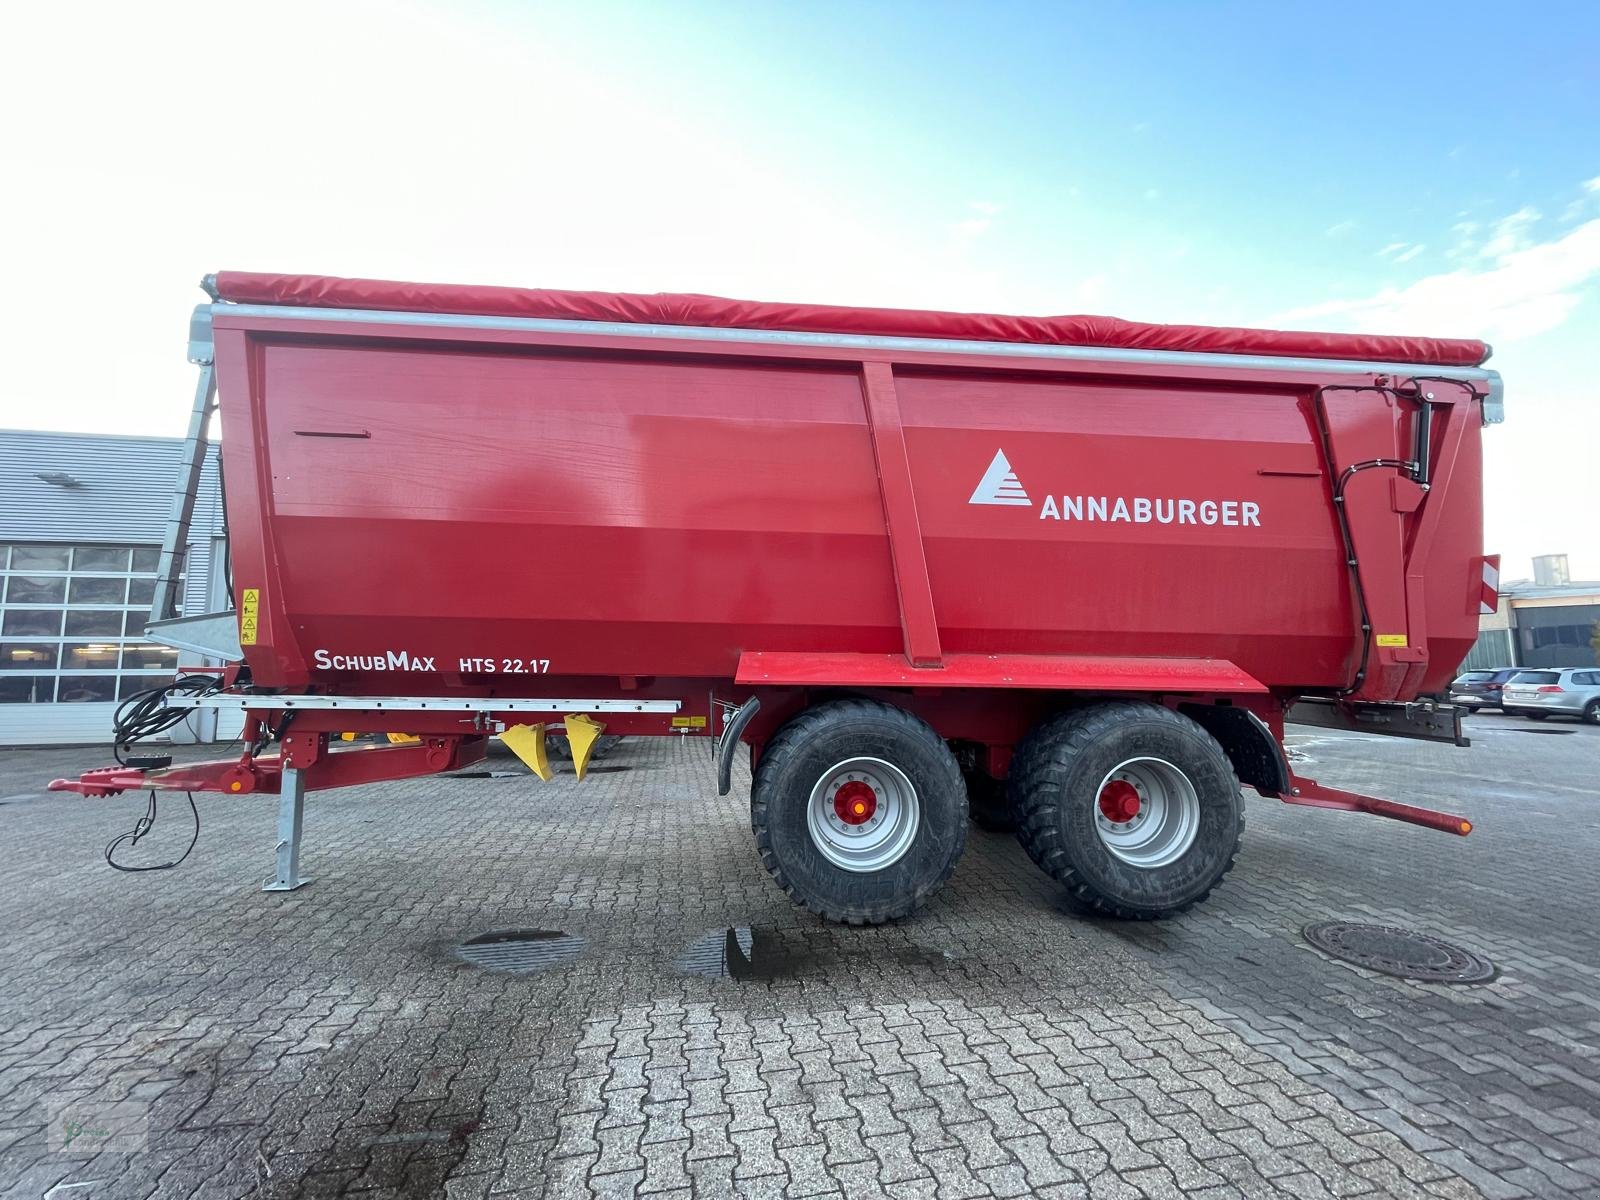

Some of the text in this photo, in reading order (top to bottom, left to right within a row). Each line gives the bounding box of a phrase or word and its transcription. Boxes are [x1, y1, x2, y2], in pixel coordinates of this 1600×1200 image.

[1039, 494, 1261, 527] ANNABURGER
[459, 658, 496, 673] HTS
[502, 658, 550, 674] 22.17
